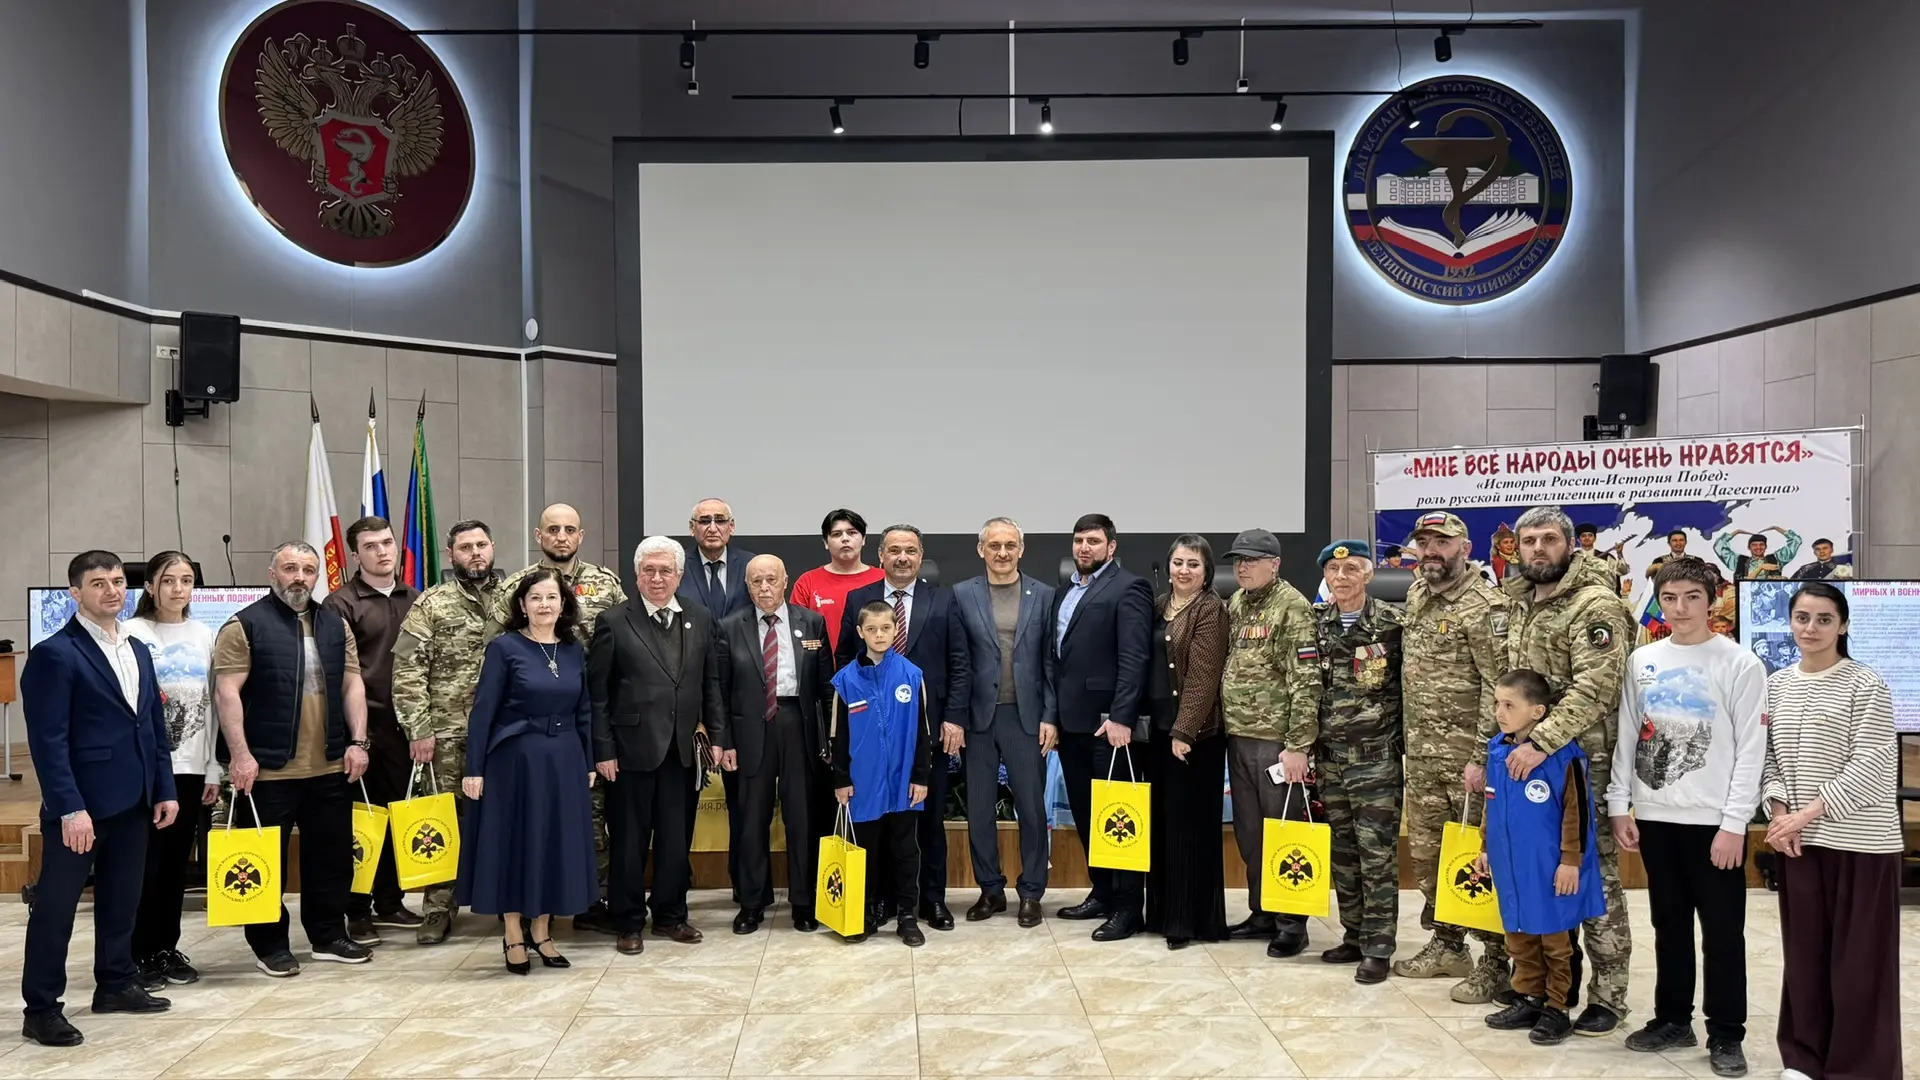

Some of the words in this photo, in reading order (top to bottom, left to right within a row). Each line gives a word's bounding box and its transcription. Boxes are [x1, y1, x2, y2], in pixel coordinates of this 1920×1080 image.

[1353, 84, 1439, 182] ДАГЕСТАНСЙ
[1364, 233, 1464, 297] МЕДИЦИНСКИЙ
[1443, 265, 1476, 279] 1932
[1404, 456, 1458, 478] «МНЕ
[1465, 453, 1500, 476] ВСЕ
[1506, 450, 1596, 474] НАРОДЫ
[1602, 446, 1672, 469] ОЧЕНЬ
[1680, 440, 1813, 467] НРАВЯТСЯ»
[1477, 476, 1546, 491] «История
[1551, 472, 1672, 488] России-История
[1677, 470, 1729, 483] Побед:
[1416, 496, 1446, 507] роль
[1450, 492, 1500, 506] русской
[1505, 489, 1614, 502] интеллигенции
[1618, 491, 1625, 499] в
[1629, 488, 1701, 501] развитии
[1705, 484, 1800, 498] Дагестана»
[192, 594, 225, 602] ОЕННЫХ
[1852, 588, 1888, 596] МИРНЫХ
[1890, 588, 1896, 596] И
